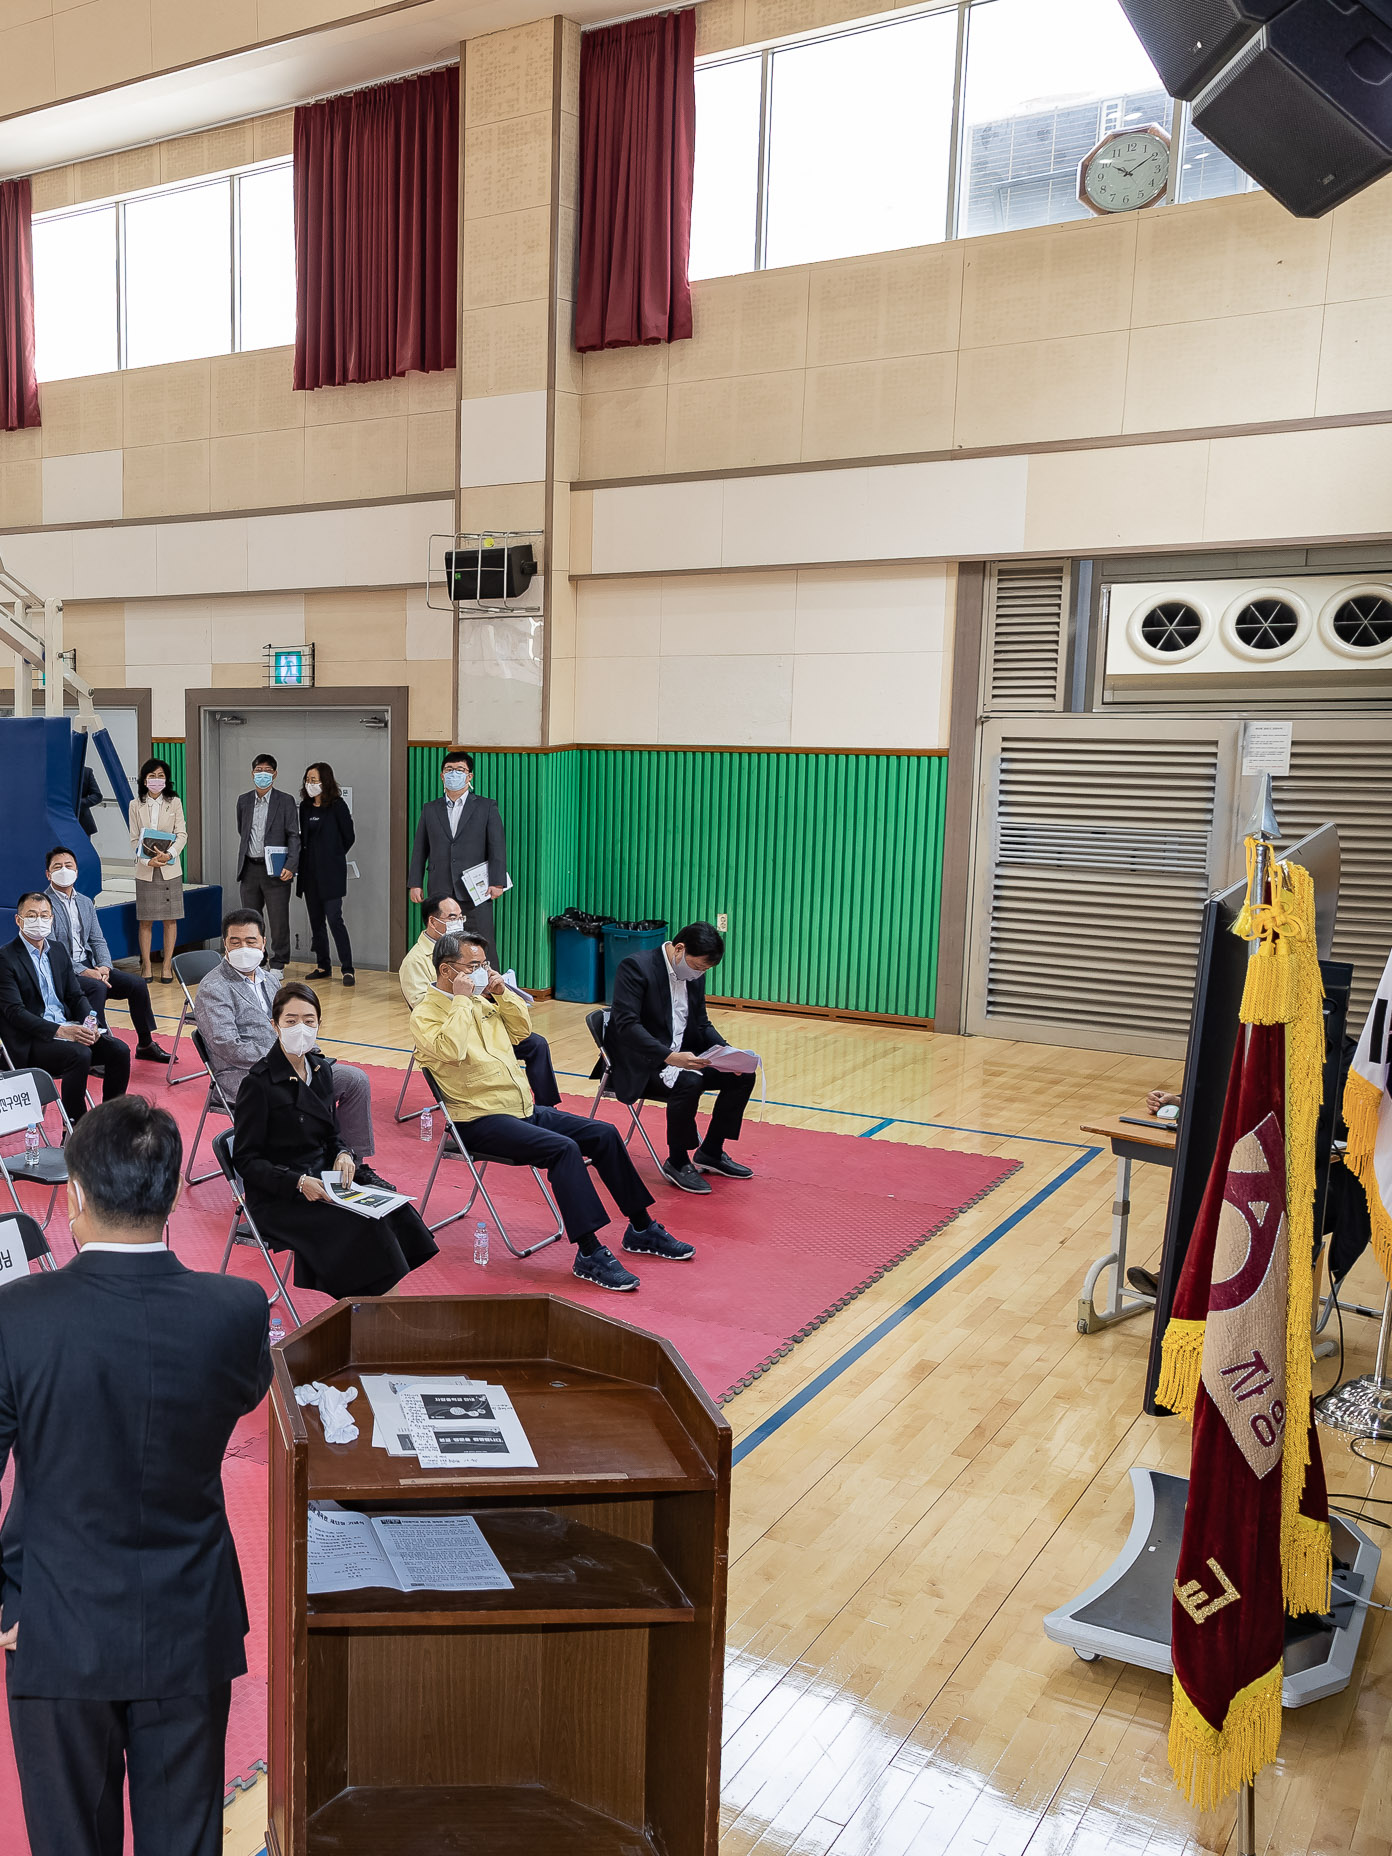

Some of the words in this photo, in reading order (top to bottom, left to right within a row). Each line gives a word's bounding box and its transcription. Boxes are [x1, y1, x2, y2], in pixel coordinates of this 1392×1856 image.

[1126, 143, 1137, 152] 12
[1143, 144, 1147, 153] 1
[1112, 148, 1121, 158] 11
[1151, 152, 1159, 161] 2
[1154, 165, 1160, 174] 3
[1097, 173, 1105, 182] 9
[1148, 178, 1155, 187] 4
[1099, 185, 1107, 194] 8
[1109, 193, 1116, 202] 7
[1122, 194, 1130, 203] 6
[1137, 190, 1145, 199] 5
